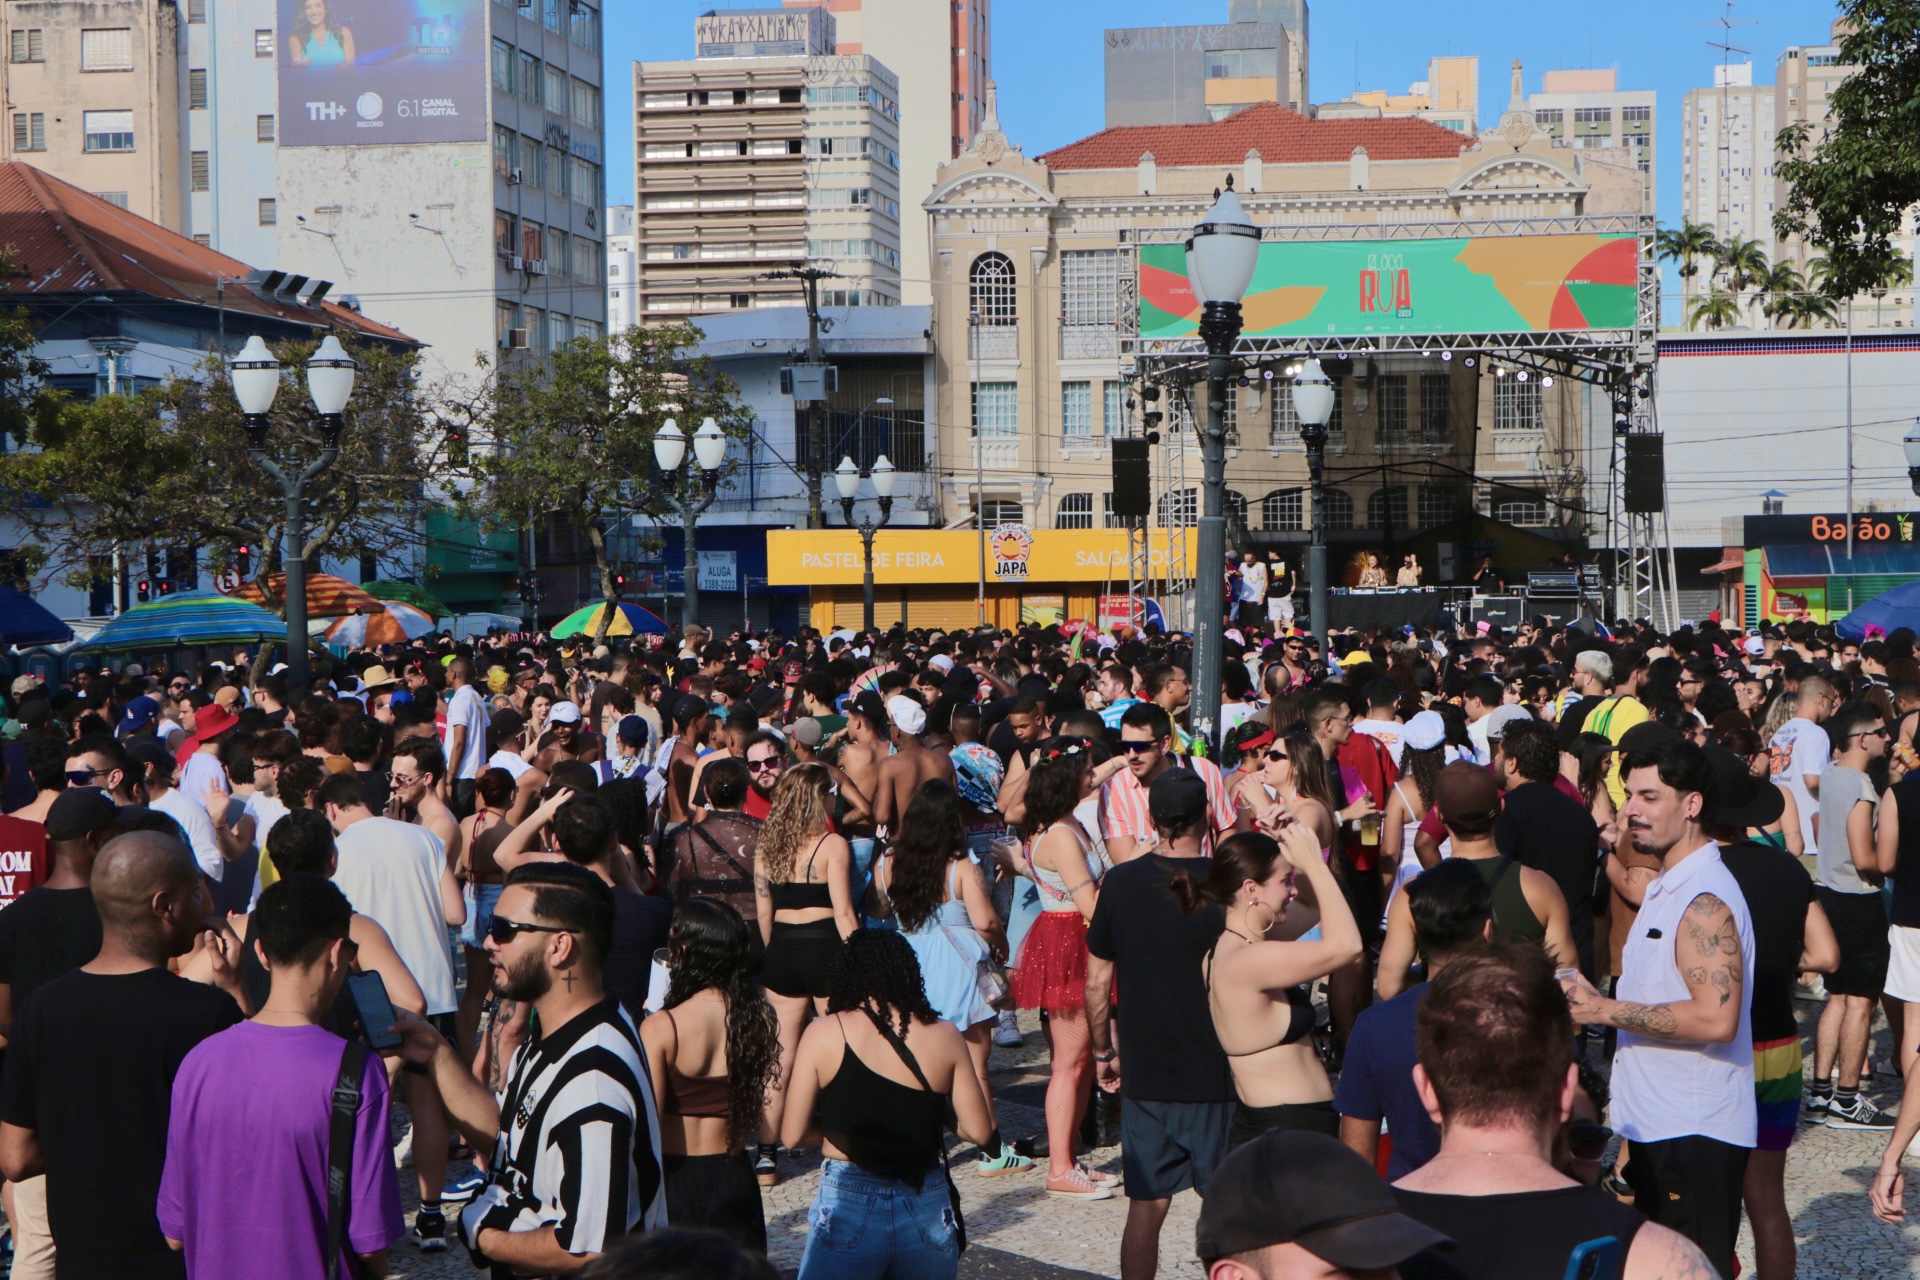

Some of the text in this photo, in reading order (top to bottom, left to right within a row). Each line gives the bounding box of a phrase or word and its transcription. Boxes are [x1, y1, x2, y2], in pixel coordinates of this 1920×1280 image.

[306, 101, 347, 121] TH+
[397, 98, 454, 118] 6.1 CANAL
[421, 107, 458, 116] DIGITAL
[1359, 268, 1412, 312] RUA
[1811, 515, 1891, 541] Barão
[801, 552, 945, 568] PASTEL DE FEIRA
[994, 561, 1028, 575] JAPA
[707, 566, 732, 577] ALUGA
[704, 579, 736, 590] 3388-2222
[0, 851, 32, 873] OM
